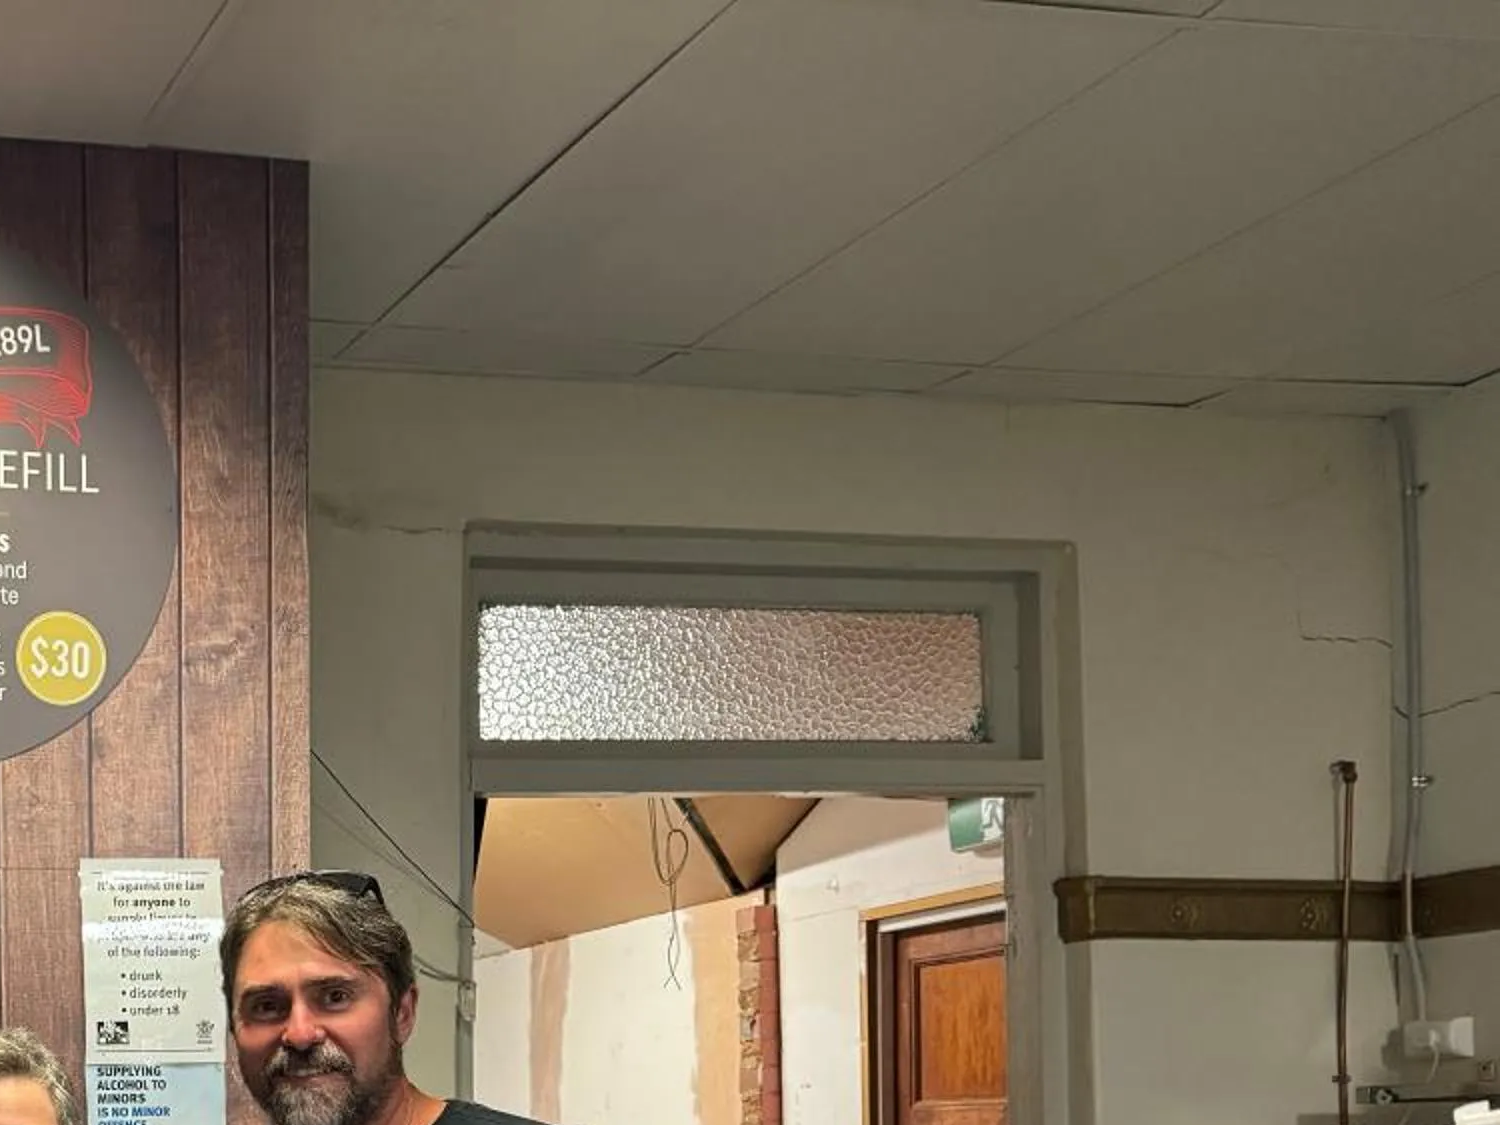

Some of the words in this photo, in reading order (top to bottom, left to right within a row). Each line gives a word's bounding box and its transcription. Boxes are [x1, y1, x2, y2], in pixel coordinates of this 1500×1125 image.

[30, 635, 91, 680] $30
[113, 895, 129, 907] for
[133, 898, 176, 910] anyone
[179, 897, 191, 907] to
[143, 945, 202, 959] following:
[129, 968, 163, 981] drunk
[129, 986, 188, 1001] disorderly
[129, 1004, 164, 1016] under
[97, 1065, 162, 1077] SUPPLYING
[97, 1079, 149, 1091] ALCOHOL
[151, 1079, 167, 1091] TO
[97, 1093, 147, 1105] MINORS
[98, 1107, 109, 1118] IS
[111, 1107, 129, 1118] NO
[132, 1106, 171, 1117] MINOR
